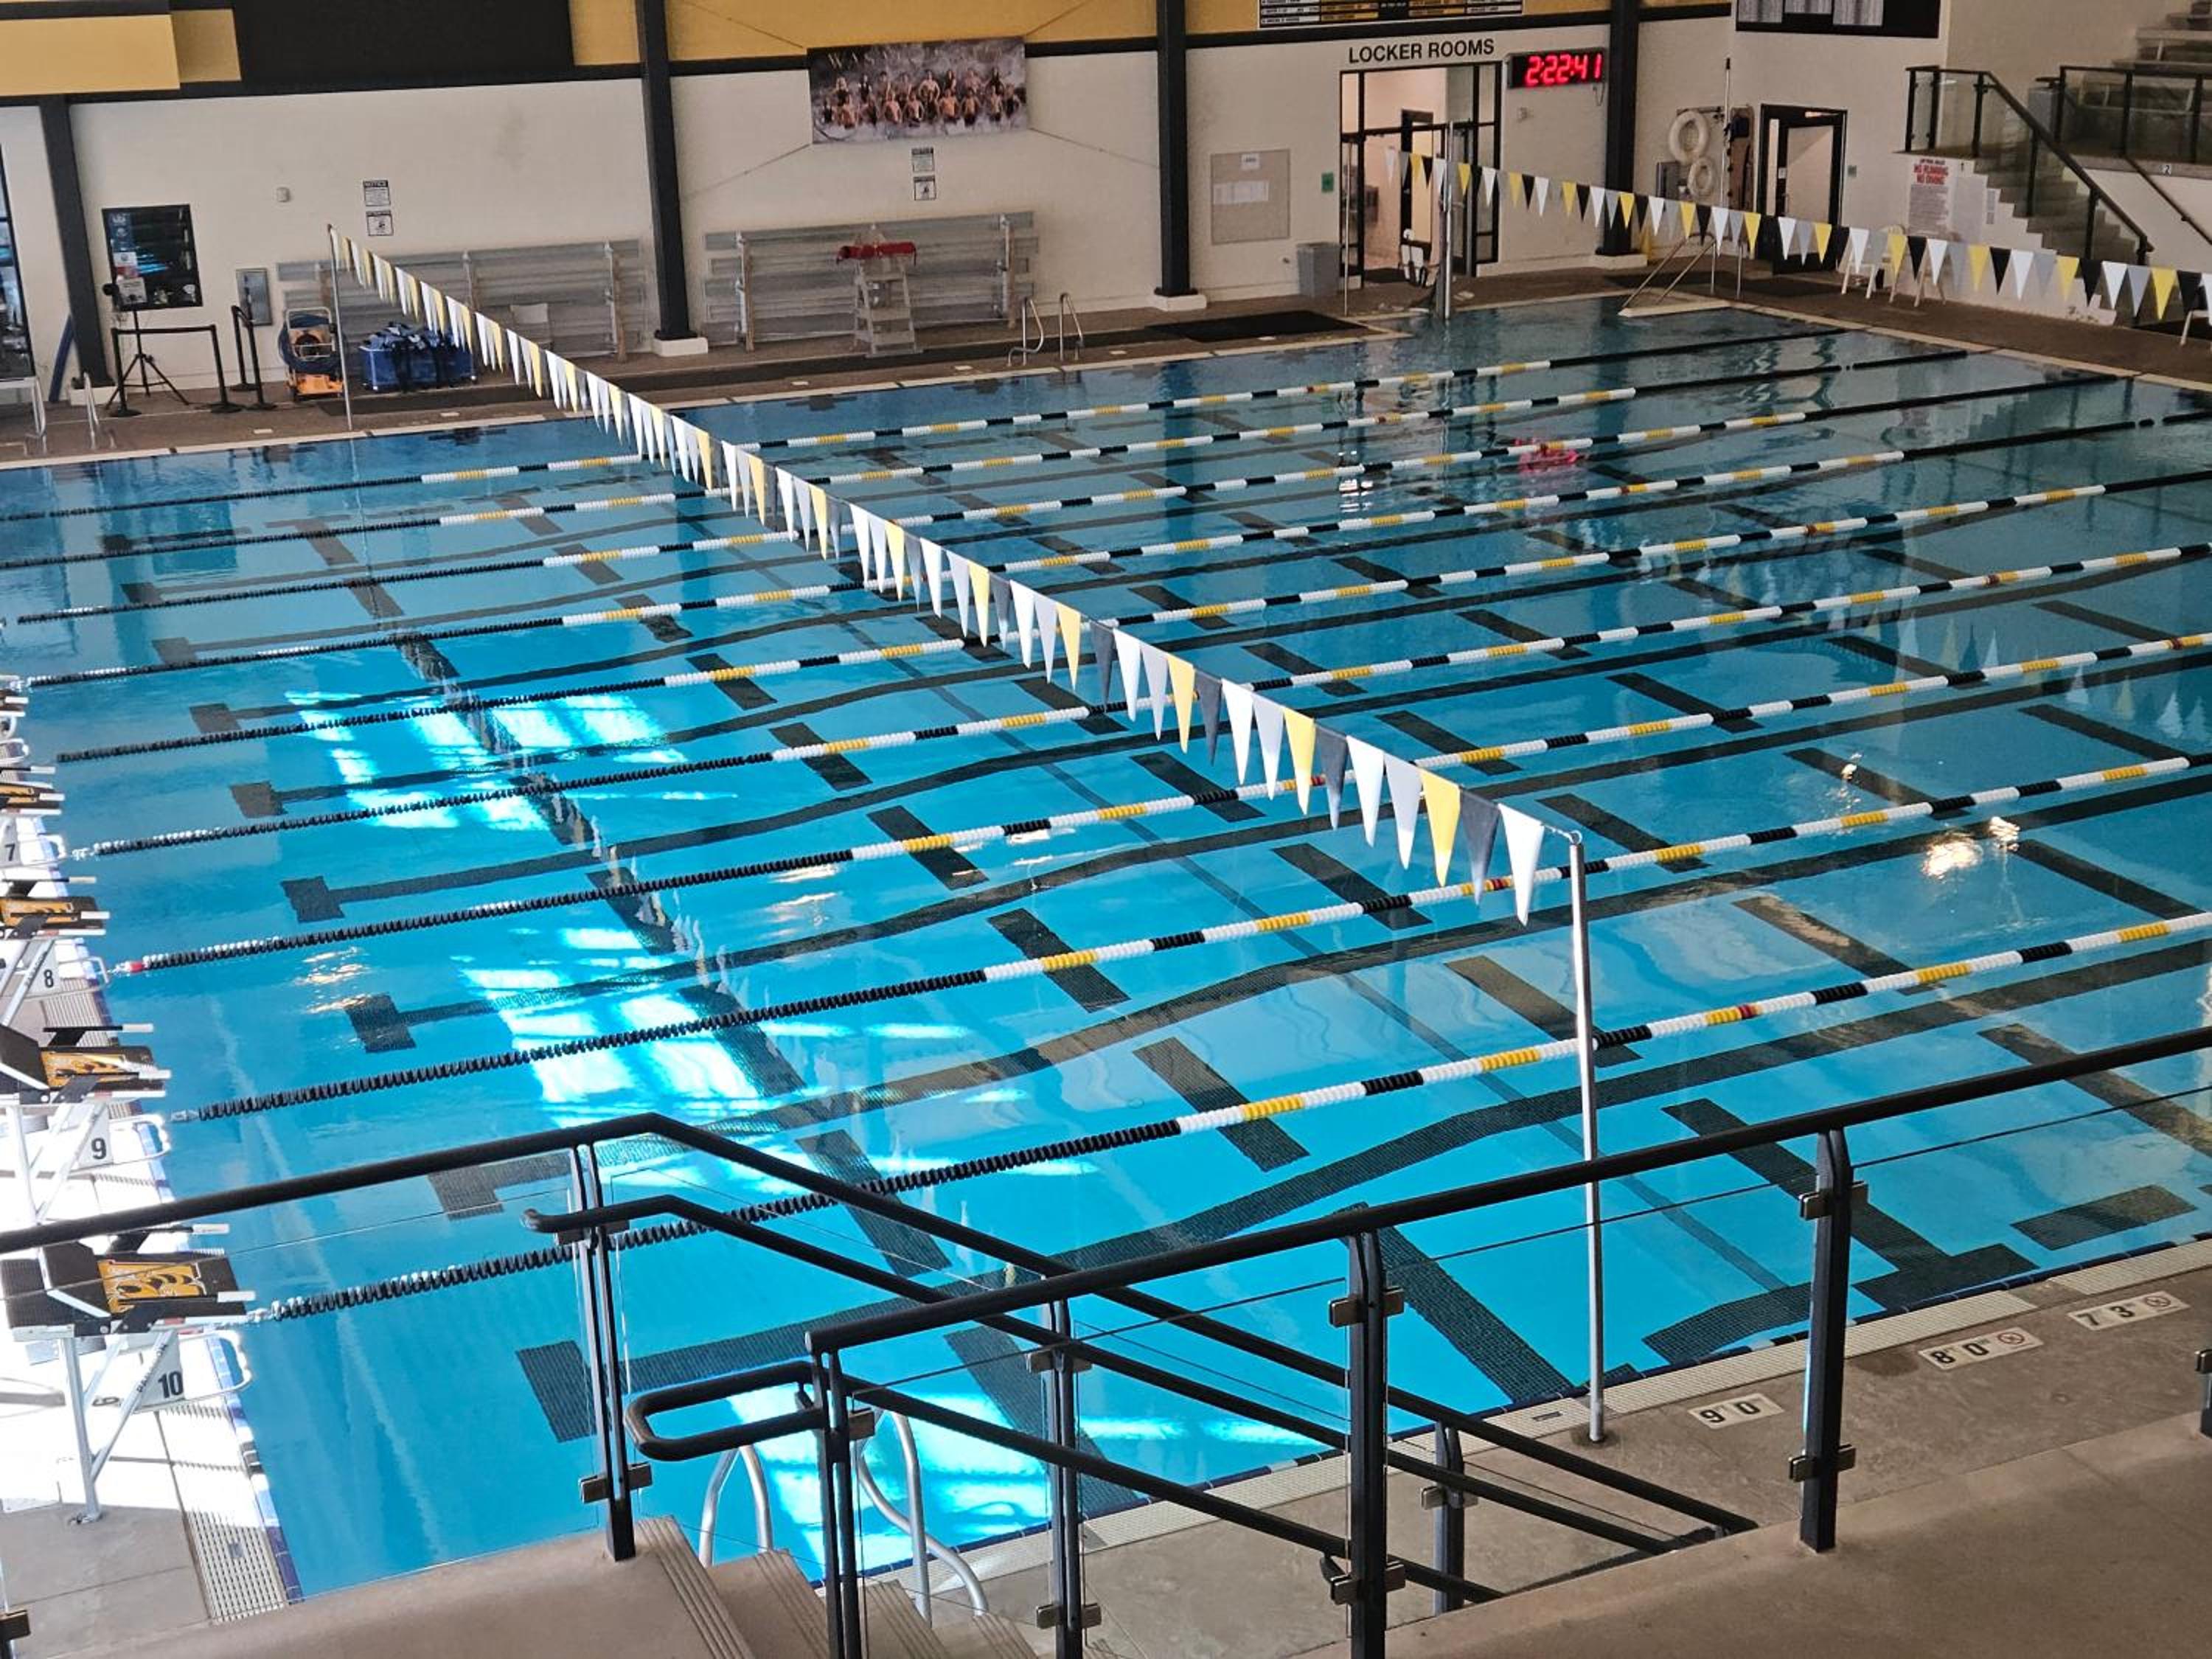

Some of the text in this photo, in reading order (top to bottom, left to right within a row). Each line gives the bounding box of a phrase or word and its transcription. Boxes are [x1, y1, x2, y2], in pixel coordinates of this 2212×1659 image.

[1349, 38, 1495, 64] LOCKER ROOMS
[1524, 52, 1603, 87] 2:22:41
[5, 844, 15, 861] 7
[44, 969, 54, 988] 8
[91, 1137, 107, 1161] 9
[2076, 1306, 2135, 1326] 7 3
[1930, 1351, 1956, 1364] 8
[157, 1370, 184, 1399] 10
[1700, 1409, 1725, 1423] 9
